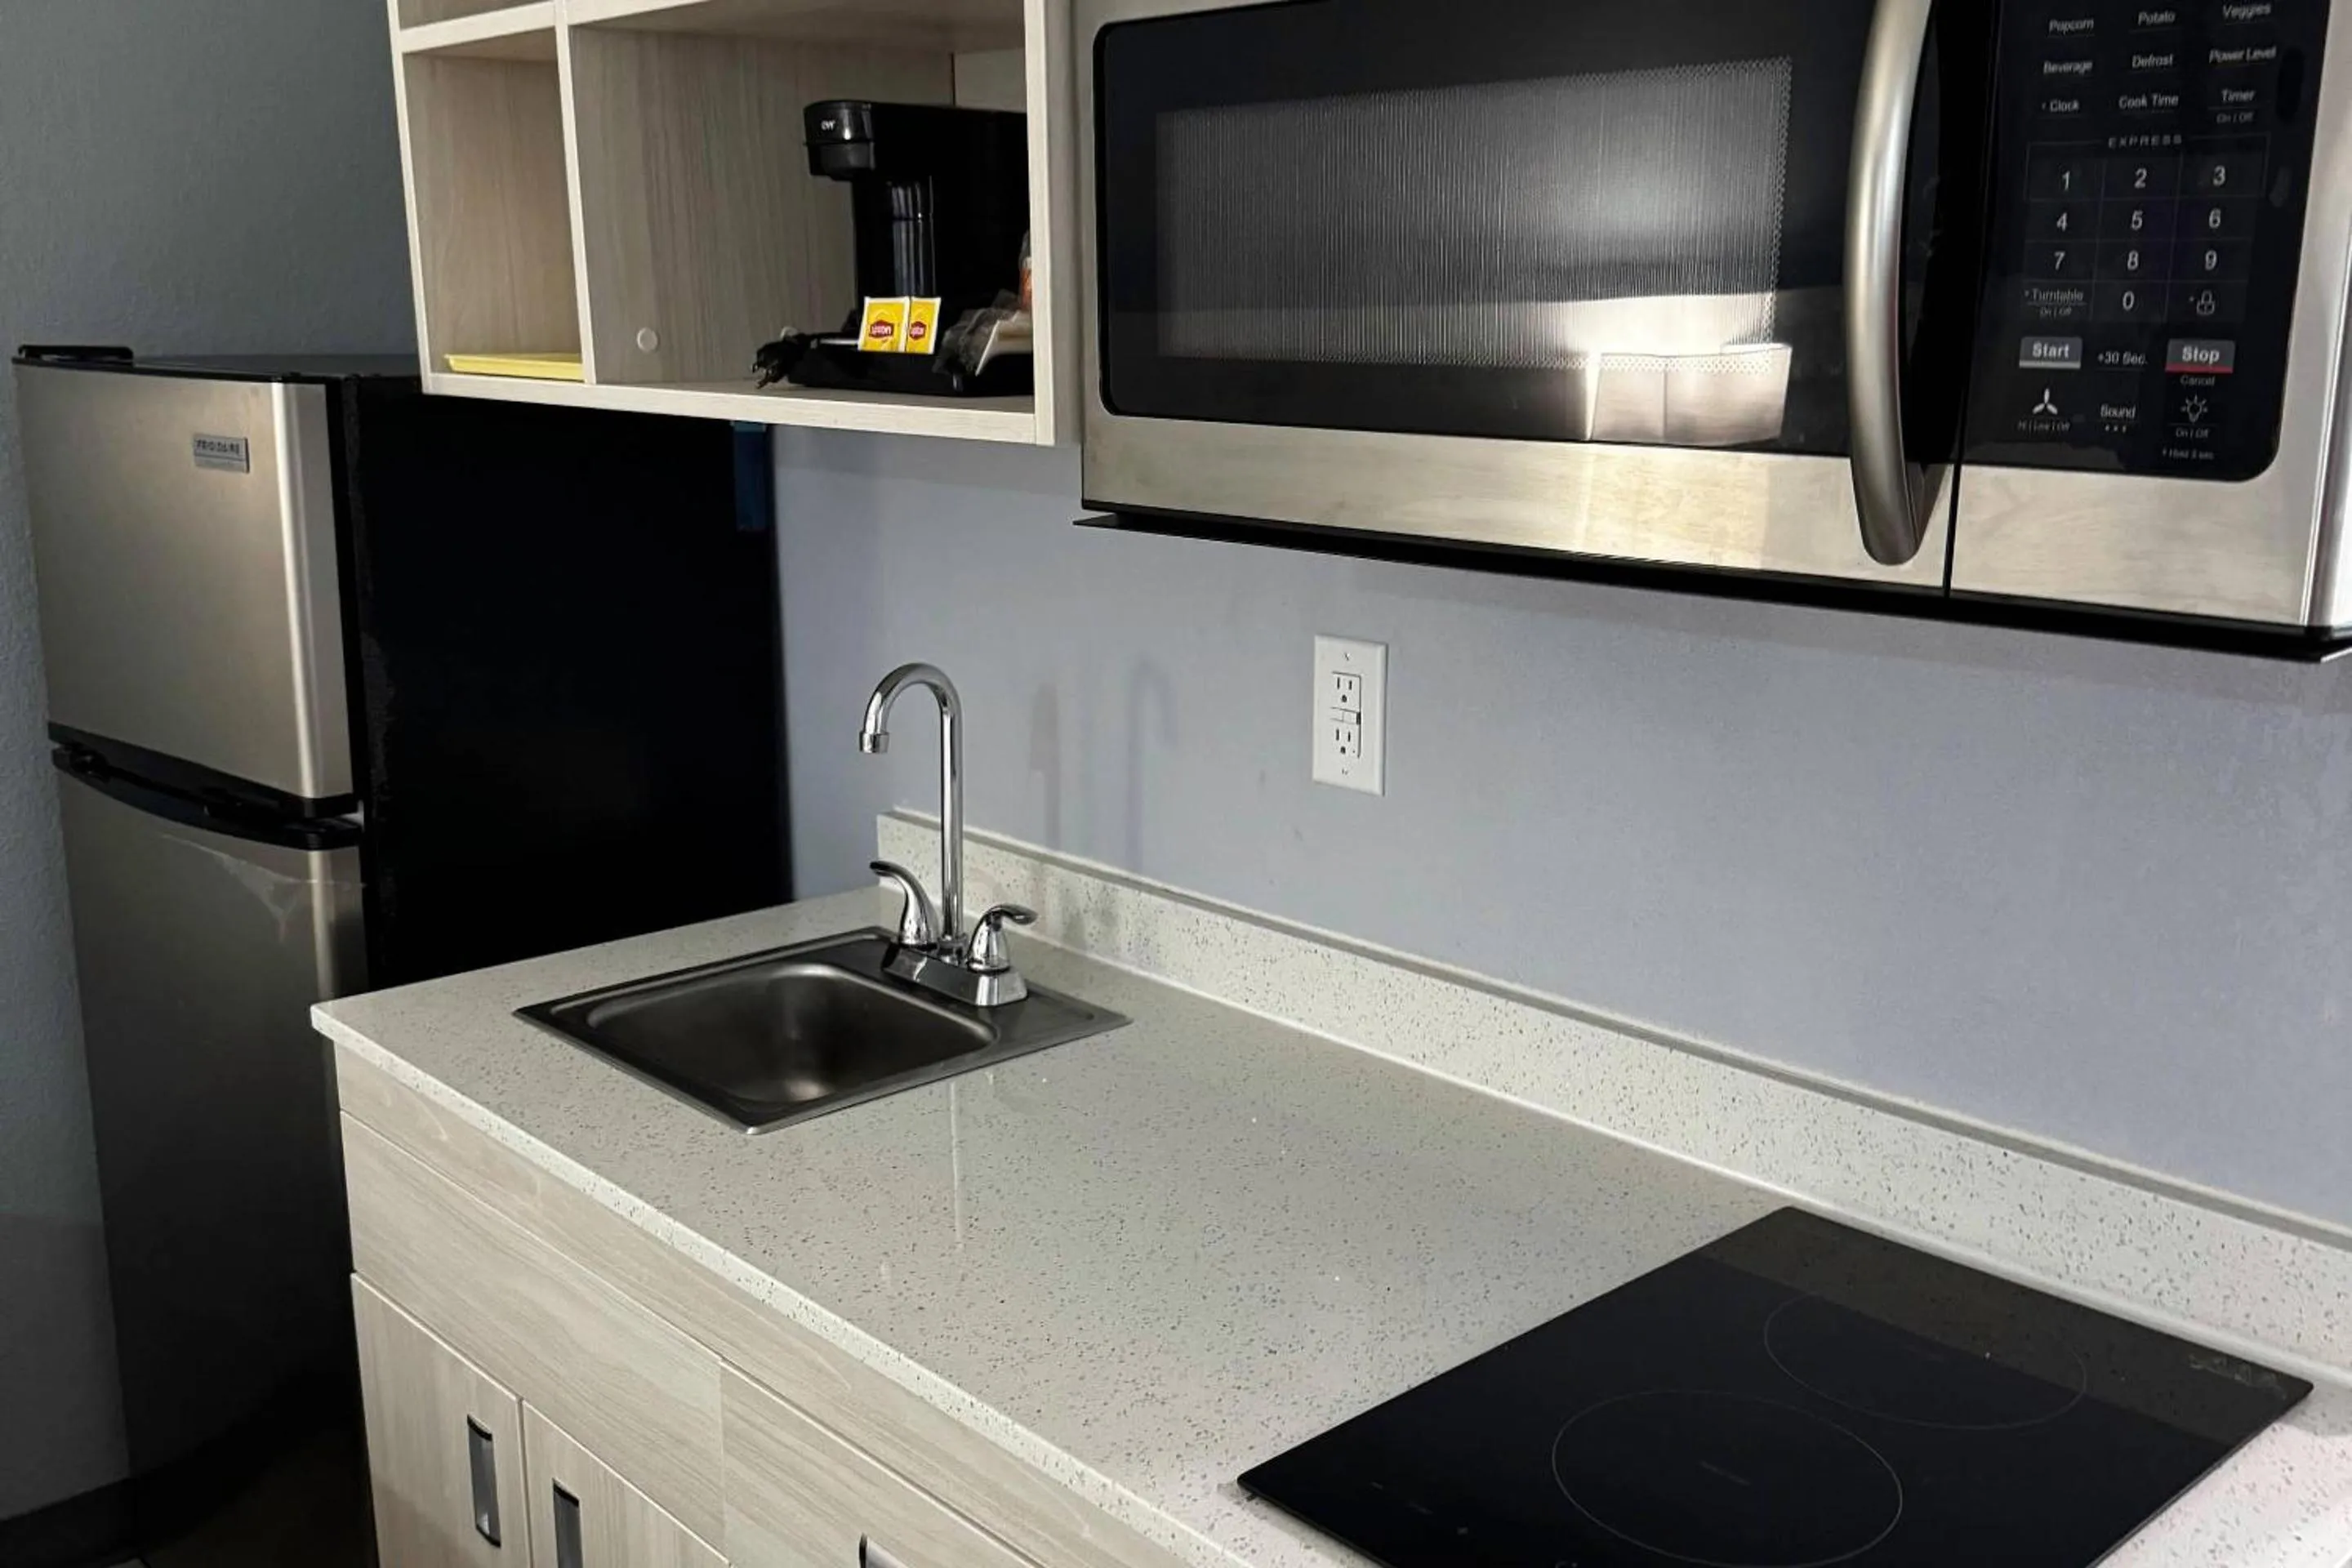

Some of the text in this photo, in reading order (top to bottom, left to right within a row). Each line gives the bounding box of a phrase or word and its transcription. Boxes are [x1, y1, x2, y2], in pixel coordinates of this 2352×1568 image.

[2138, 11, 2176, 25] Potato
[2222, 2, 2271, 18] Veggies
[2049, 18, 2094, 34] Popcorn
[2132, 54, 2174, 68] Defrost
[2208, 46, 2277, 63] Power Level
[2043, 60, 2093, 74] Beverage
[2119, 93, 2179, 109] Cook Time
[2221, 89, 2256, 103] Timer
[2050, 99, 2079, 113] Clock
[2108, 134, 2182, 149] EXPRESS
[2062, 171, 2071, 190] 1
[2134, 168, 2148, 189] 2
[2212, 166, 2226, 186] 3
[2056, 212, 2068, 231] 4
[2132, 210, 2144, 230] 5
[2208, 208, 2221, 229] 6
[2054, 251, 2066, 270] 7
[2127, 250, 2140, 270] 8
[2205, 250, 2217, 270] 9
[2031, 288, 2084, 303] Turntable
[2123, 291, 2135, 310] 0
[2033, 342, 2069, 360] Start
[2097, 352, 2120, 365] +30
[2182, 345, 2220, 364] Stop
[2180, 375, 2216, 387] Cancel
[2100, 404, 2136, 419] Sound
